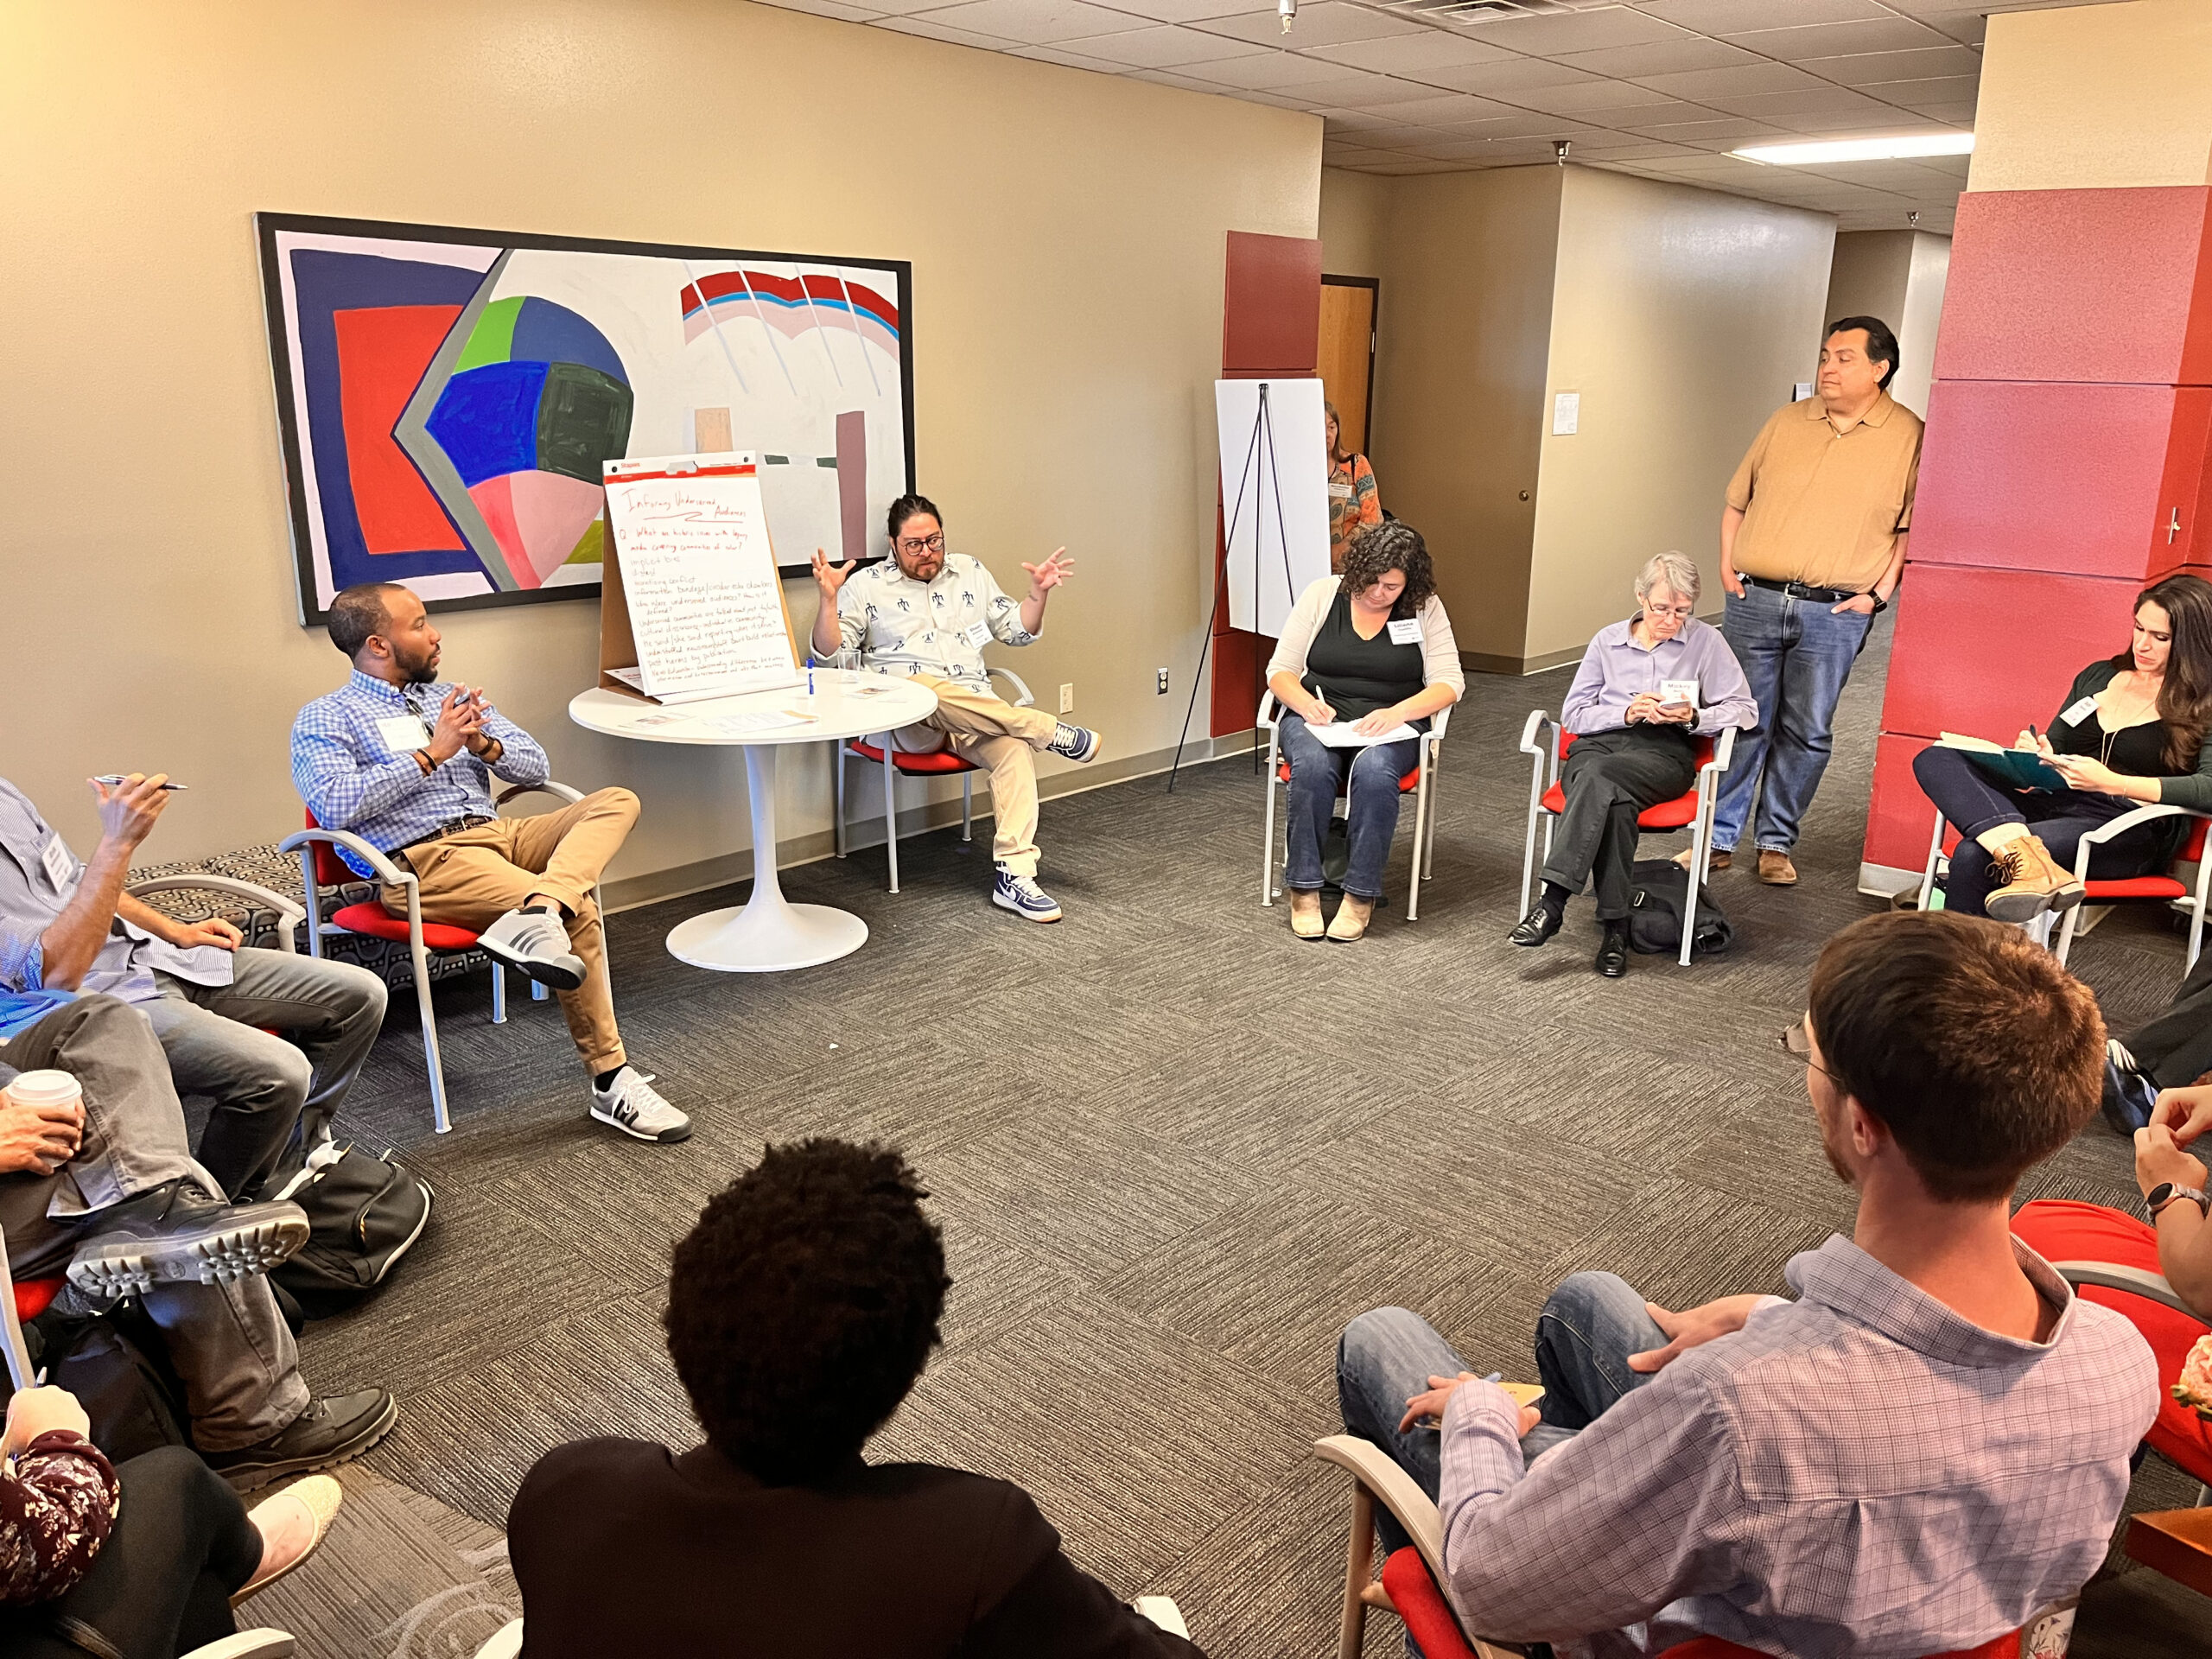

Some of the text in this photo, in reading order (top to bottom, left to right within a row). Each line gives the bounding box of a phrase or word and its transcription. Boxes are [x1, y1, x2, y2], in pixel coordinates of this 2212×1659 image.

[621, 488, 715, 512] Informing Underserved
[715, 505, 747, 518] Audiences
[637, 527, 657, 537] What
[715, 527, 728, 536] with
[652, 543, 677, 553] covering
[669, 575, 697, 584] conflict
[691, 655, 702, 664] by
